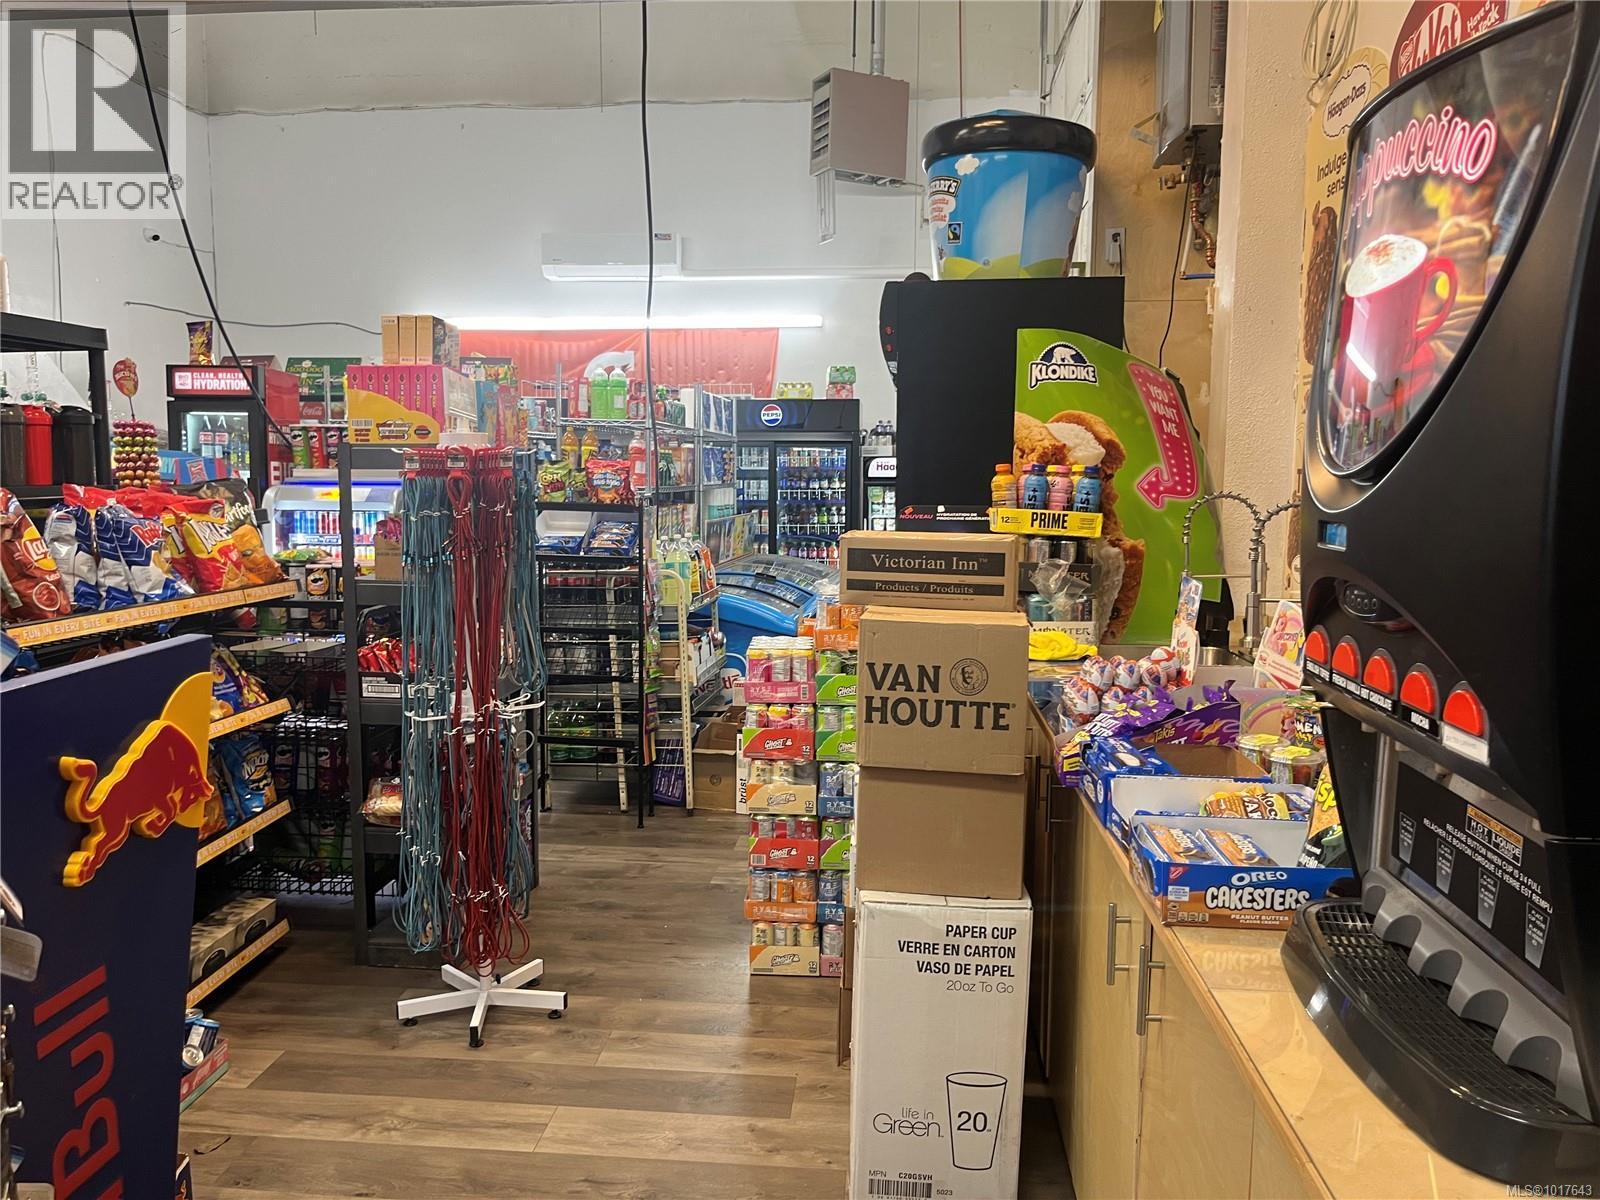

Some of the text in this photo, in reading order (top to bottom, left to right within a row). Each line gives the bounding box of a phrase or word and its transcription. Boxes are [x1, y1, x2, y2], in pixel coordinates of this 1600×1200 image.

[1466, 10, 1484, 32] Have
[1317, 151, 1347, 182] Indulge
[1031, 363, 1097, 387] KLONDIKE
[1147, 383, 1168, 403] YOU
[1149, 399, 1179, 422] WANT
[1162, 419, 1180, 438] ME
[1030, 511, 1069, 530] PRIME
[871, 553, 945, 570] Victorian
[874, 582, 920, 592] Products
[930, 584, 974, 594] Produits
[23, 628, 41, 640] FUN
[54, 622, 80, 634] EVERY
[866, 662, 942, 694] VAN
[1411, 712, 1430, 730] MOCHA
[1154, 726, 1176, 743] Takis
[1471, 820, 1489, 836] HOT
[1492, 833, 1521, 856] LIQUIDE
[1446, 823, 1467, 842] RELEASE
[1467, 837, 1486, 856] BUTTON
[1487, 850, 1502, 867] WHEN
[1502, 861, 1513, 874] CUP
[1527, 878, 1542, 894] FULL
[1231, 871, 1288, 886] OREO
[1446, 833, 1452, 842] LE
[1452, 838, 1472, 856] BOUTON
[1472, 851, 1496, 873] LORSQUE
[1495, 868, 1502, 878] LE
[1502, 873, 1520, 891] VERRE
[1520, 886, 1532, 898] EST
[1531, 892, 1553, 914] REMPLI
[1206, 886, 1310, 911] CAKESTERS
[945, 924, 1017, 941] PAPER CUP
[898, 940, 1016, 959] VERRE EN CARTON
[916, 960, 1015, 978] VASO DE PAPEL
[946, 980, 1014, 993] 20oz To Go
[901, 1106, 934, 1119] life in
[956, 1111, 988, 1132] 20
[873, 1112, 941, 1137] Green
[869, 1170, 887, 1178] MPN
